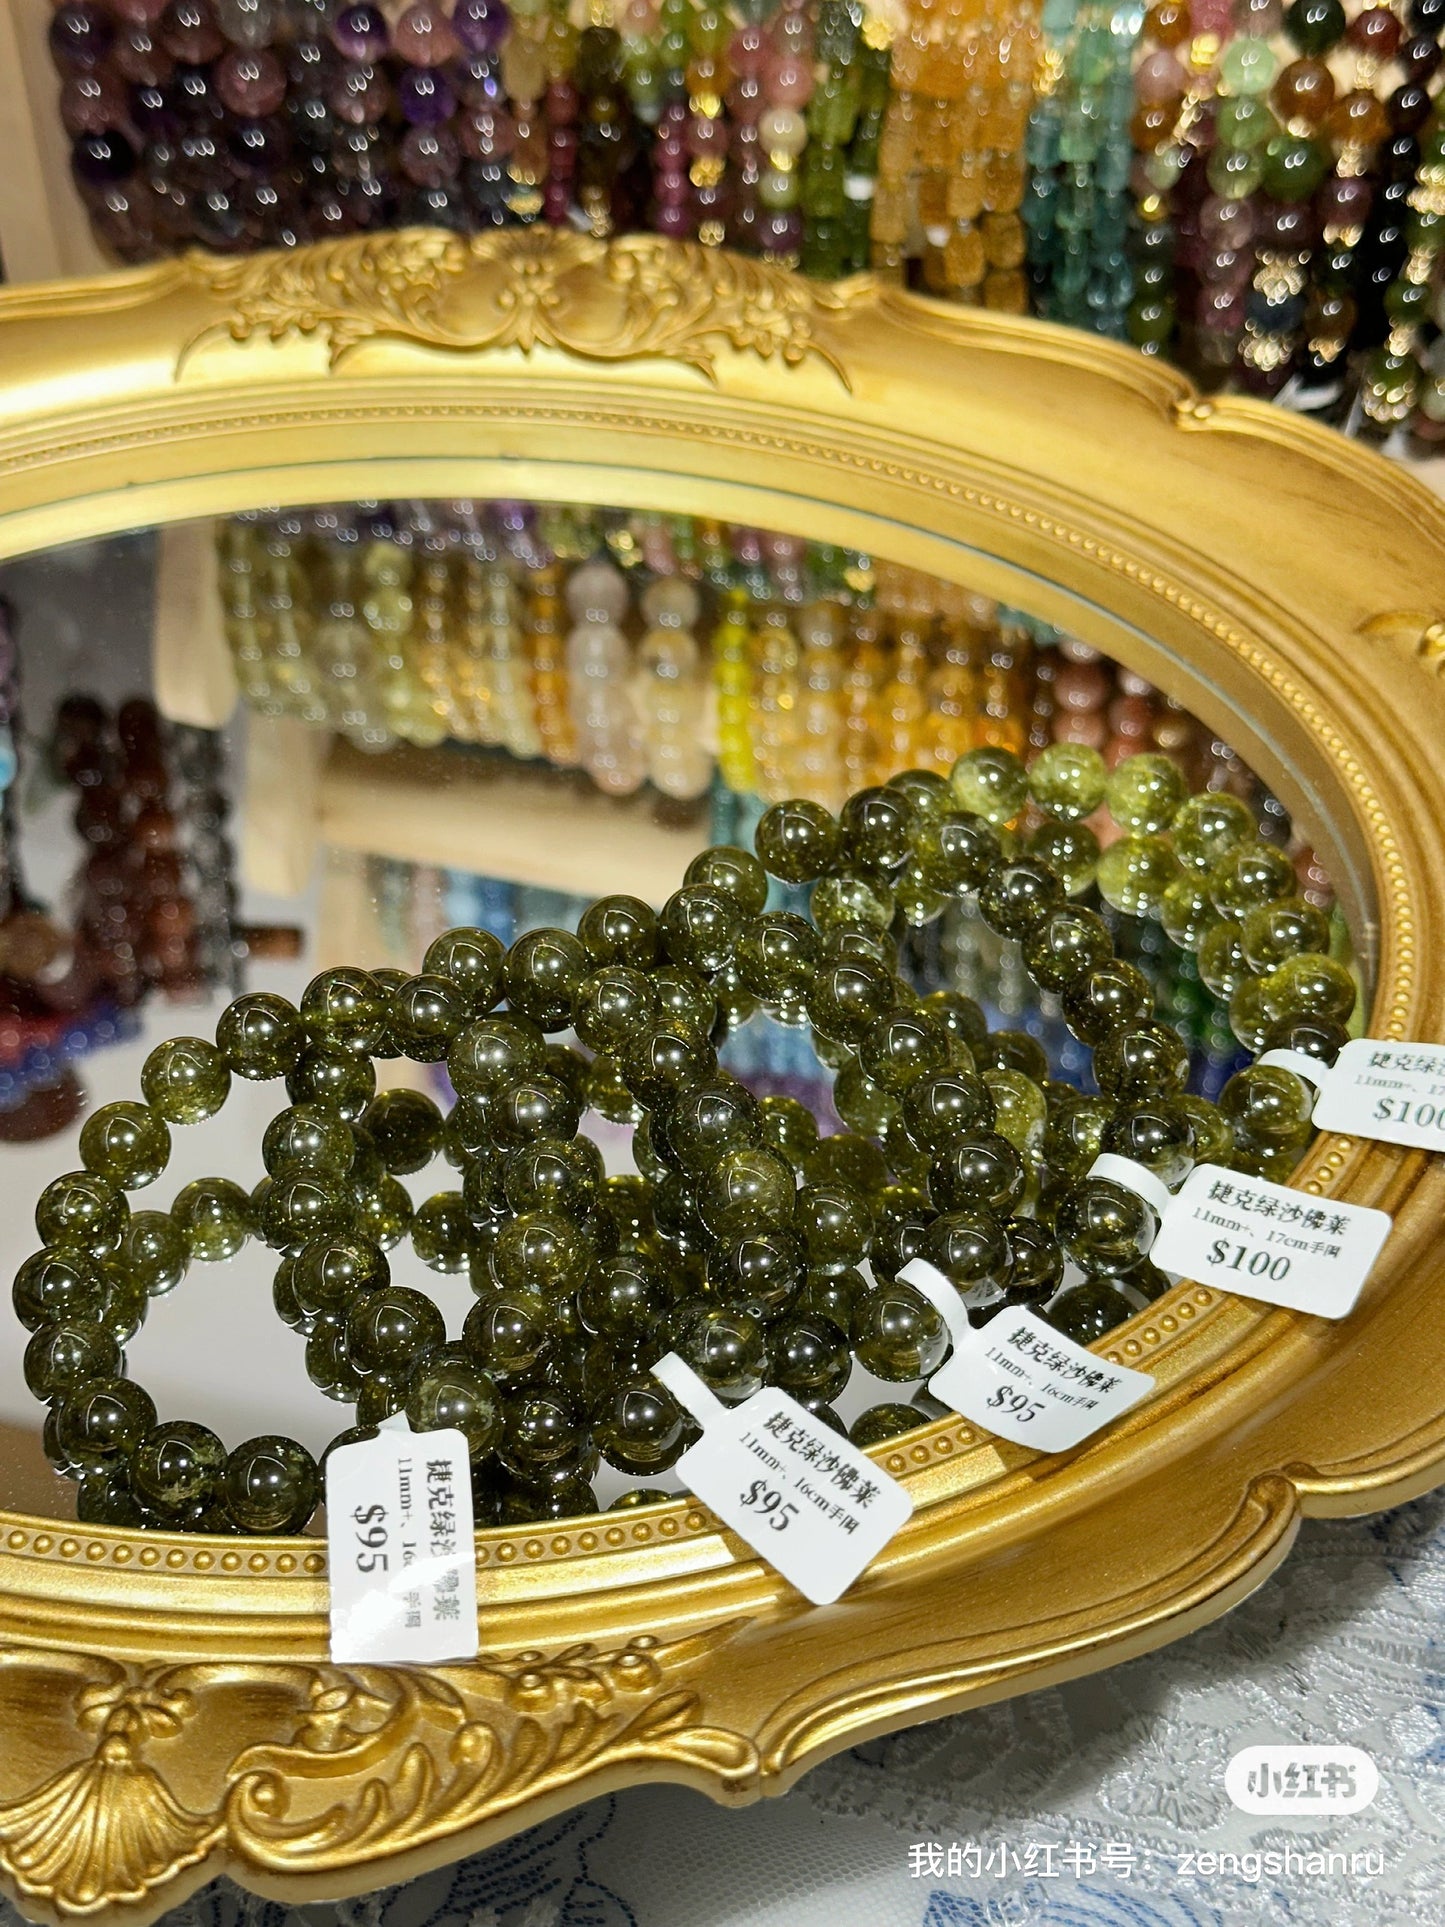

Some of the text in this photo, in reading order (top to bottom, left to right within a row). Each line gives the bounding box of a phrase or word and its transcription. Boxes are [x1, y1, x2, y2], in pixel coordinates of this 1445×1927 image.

[1206, 1237, 1291, 1281] $100
[986, 1384, 1045, 1422] $95
[740, 1479, 800, 1531] $95
[350, 1504, 389, 1573] $95
